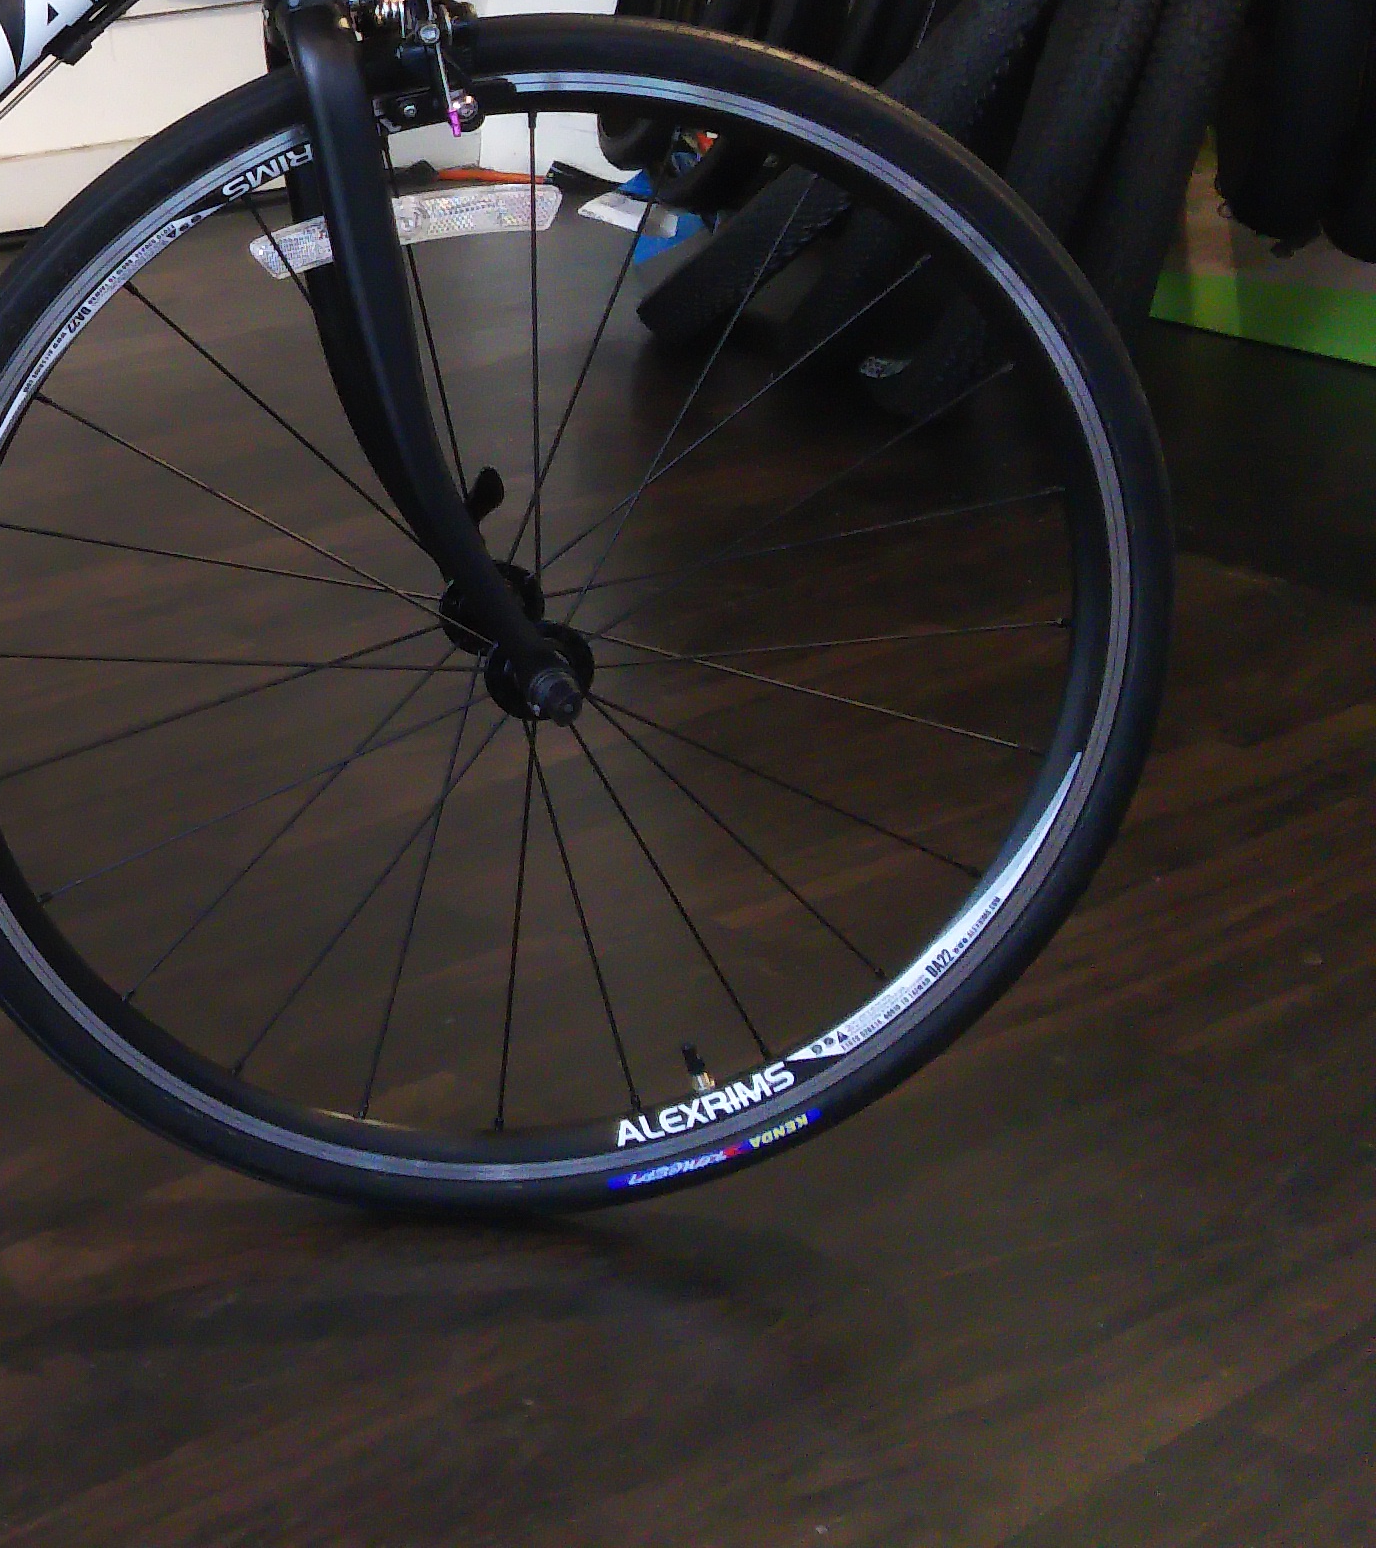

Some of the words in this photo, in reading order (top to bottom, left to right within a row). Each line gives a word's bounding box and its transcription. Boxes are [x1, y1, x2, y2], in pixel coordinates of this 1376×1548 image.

[221, 143, 315, 203] RIMS
[923, 946, 956, 979] DA22
[616, 1061, 796, 1148] ALEXRIMS
[749, 1112, 810, 1150] KENDA
